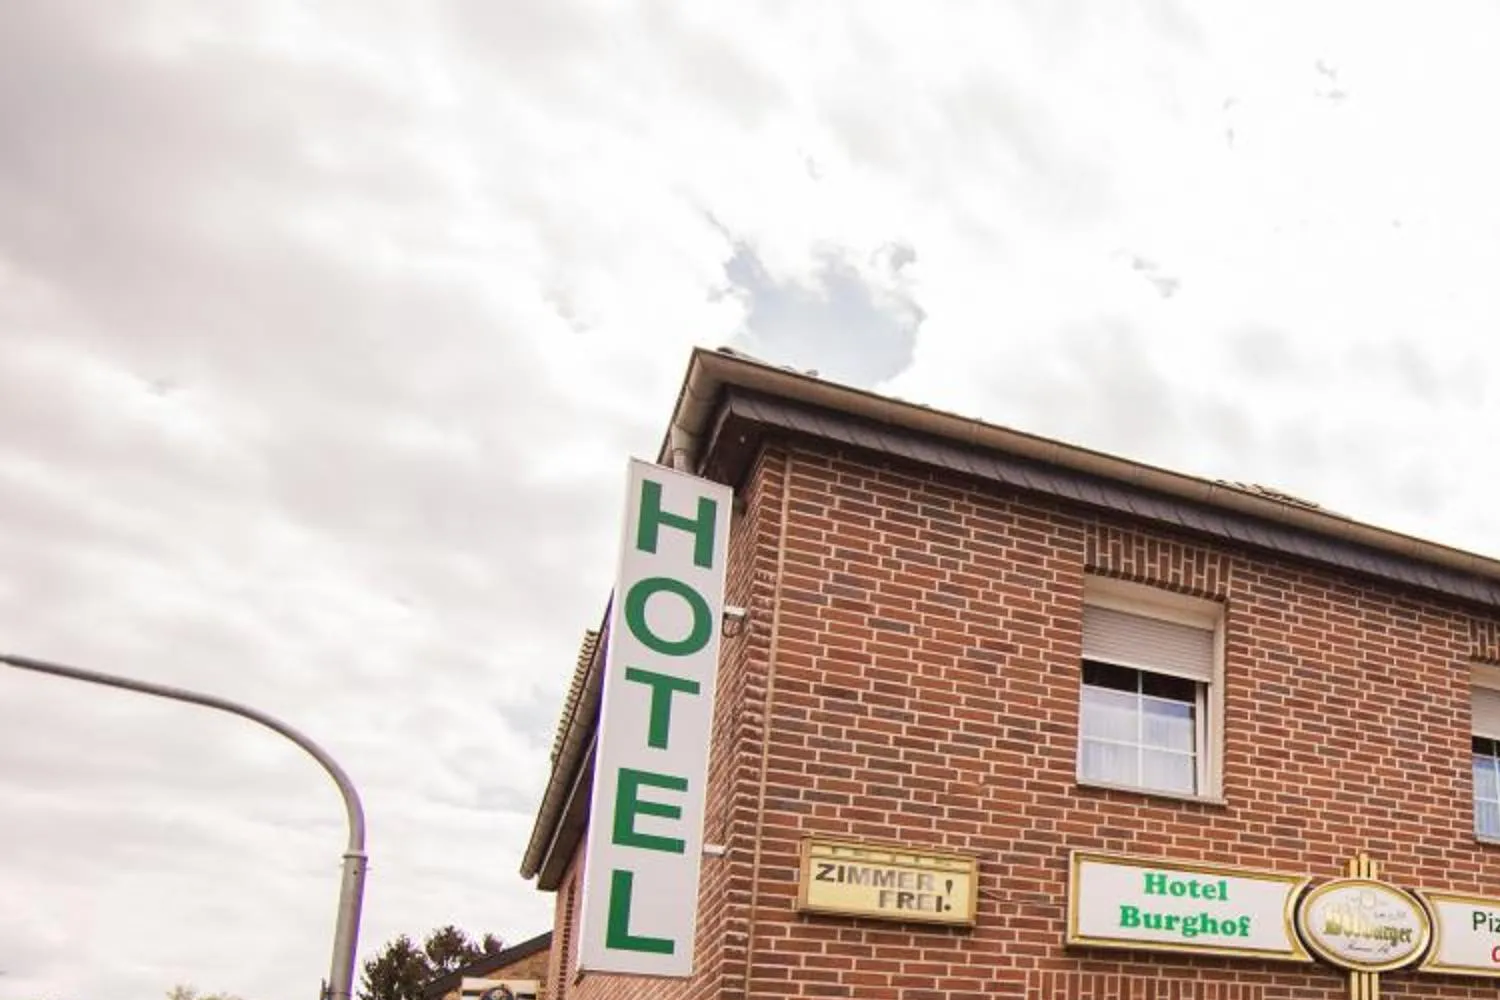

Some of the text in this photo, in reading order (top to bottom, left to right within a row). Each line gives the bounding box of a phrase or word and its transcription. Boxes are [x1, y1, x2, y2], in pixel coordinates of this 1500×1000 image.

[606, 479, 718, 955] HOTEL
[815, 863, 934, 892] ZIMMER
[1144, 873, 1228, 901] Hotel
[1119, 905, 1251, 937] Burghof
